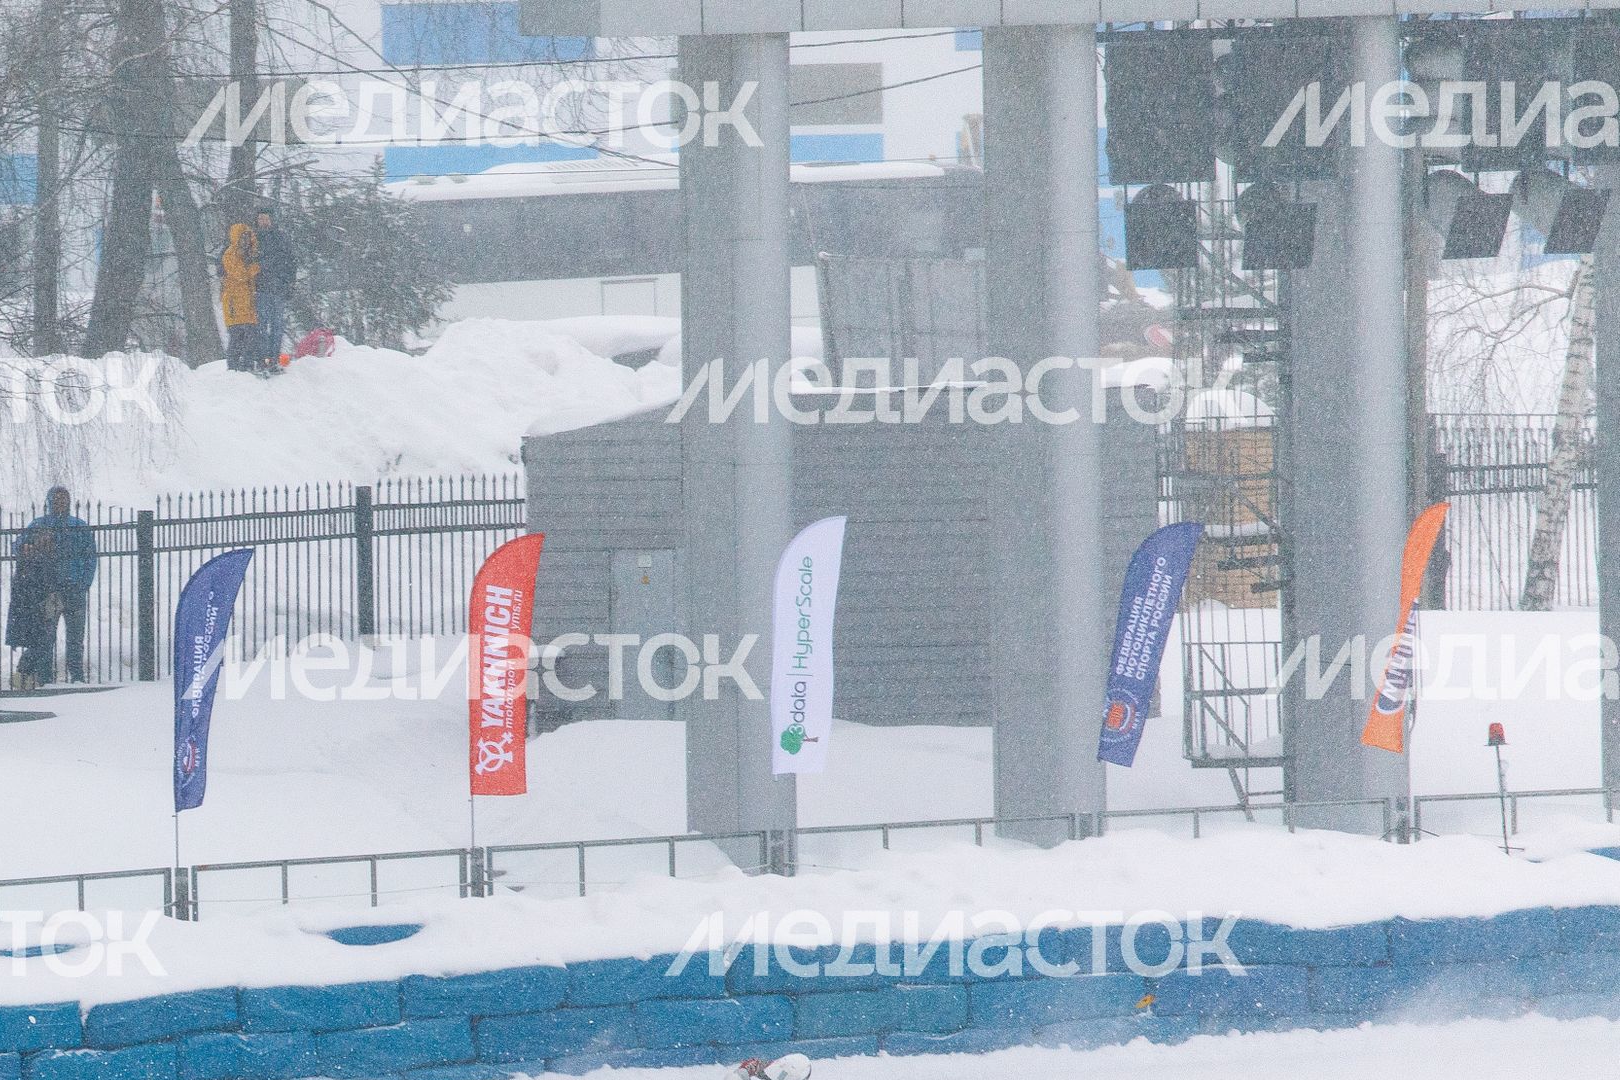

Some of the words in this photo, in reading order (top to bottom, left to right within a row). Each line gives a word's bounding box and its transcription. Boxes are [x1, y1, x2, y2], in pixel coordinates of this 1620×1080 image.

[510, 589, 523, 631] yms.ru
[1116, 596, 1144, 676] ФЕДЕРАЦИЯ
[1123, 556, 1167, 679] МОТОЦИКЛЕТНОГО
[1135, 630, 1157, 681] СПОРТА
[1151, 575, 1173, 628] РОССИИ
[480, 584, 513, 729] YAKHNICH
[504, 660, 516, 729] motorsport
[788, 680, 807, 735] 3data
